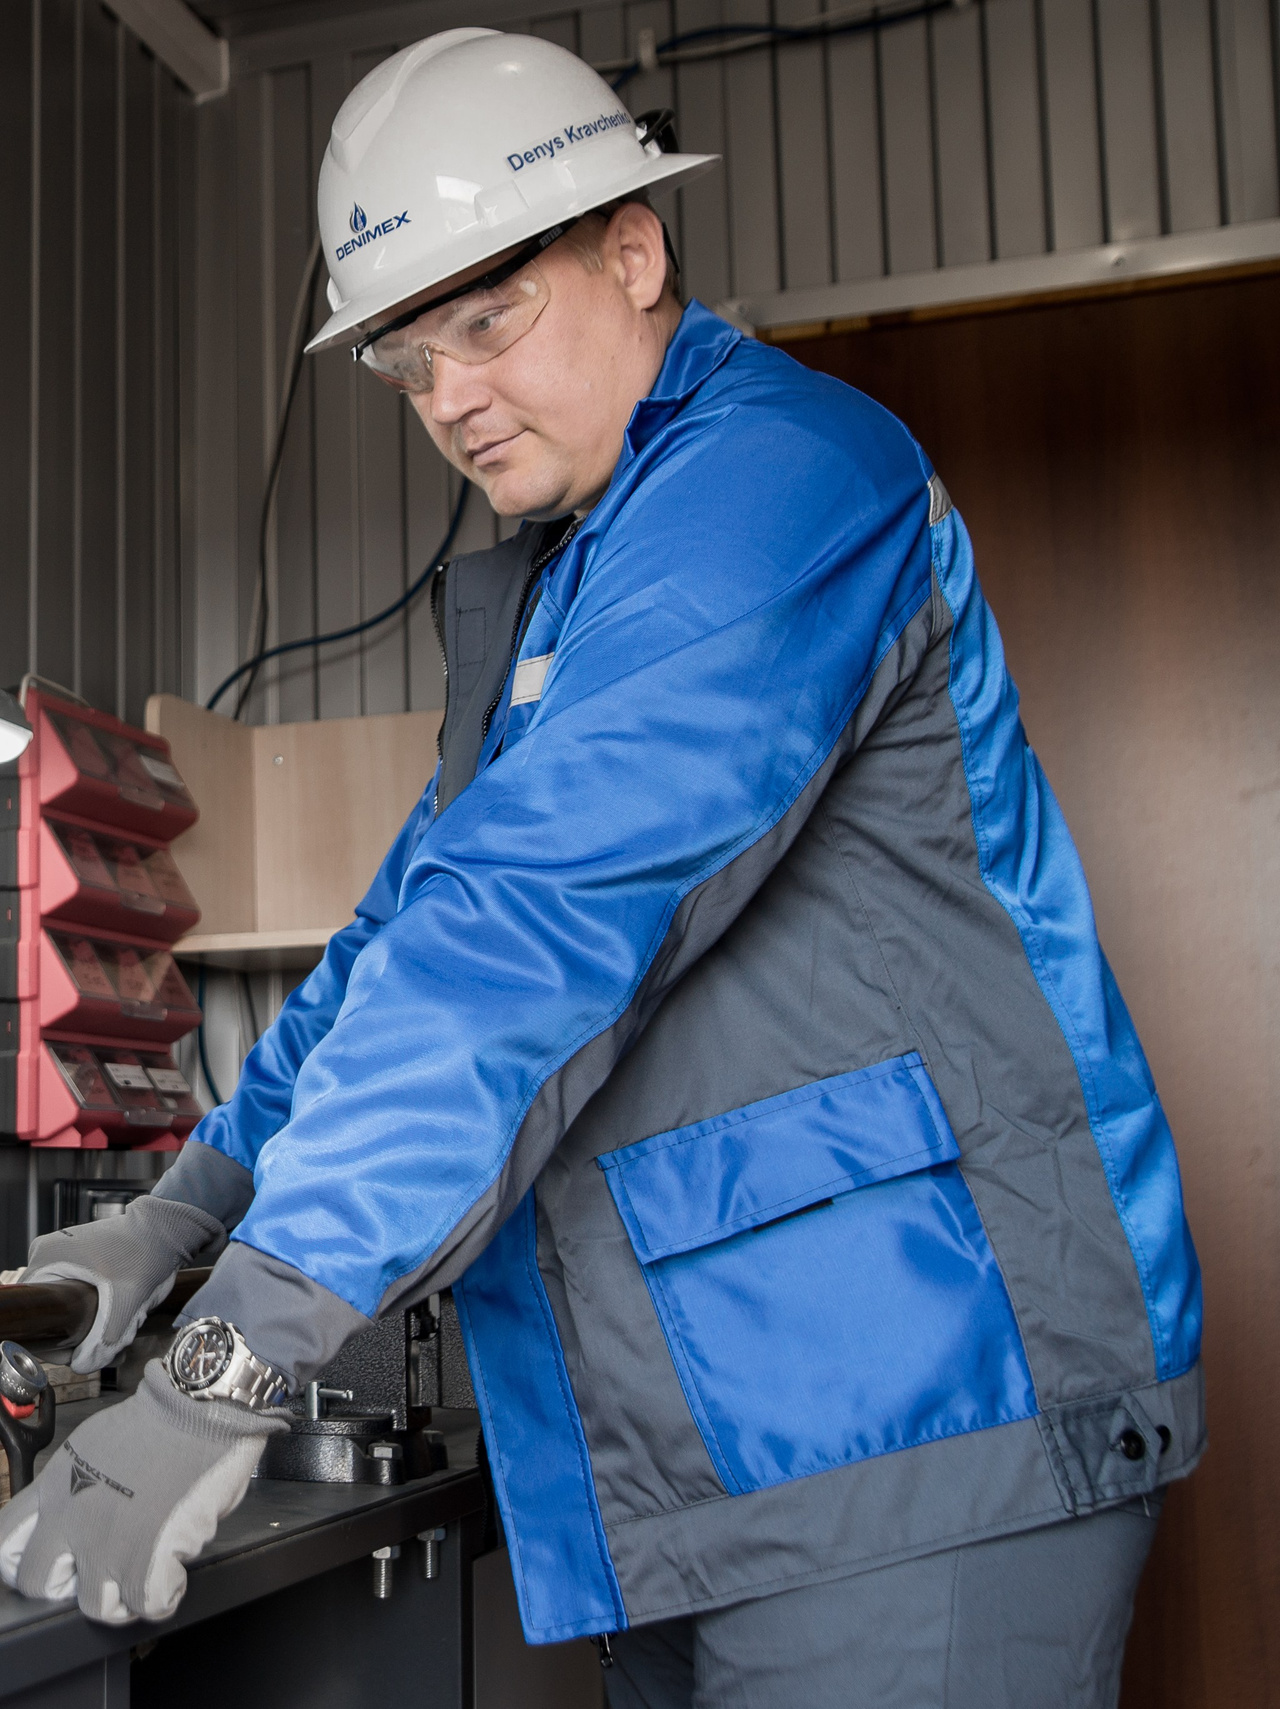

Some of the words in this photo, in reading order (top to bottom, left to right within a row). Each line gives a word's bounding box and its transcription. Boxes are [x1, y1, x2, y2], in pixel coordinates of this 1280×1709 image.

[506, 136, 565, 171] Denys
[335, 210, 412, 261] DENIMEX
[63, 1440, 135, 1499] DELTAPLUS
